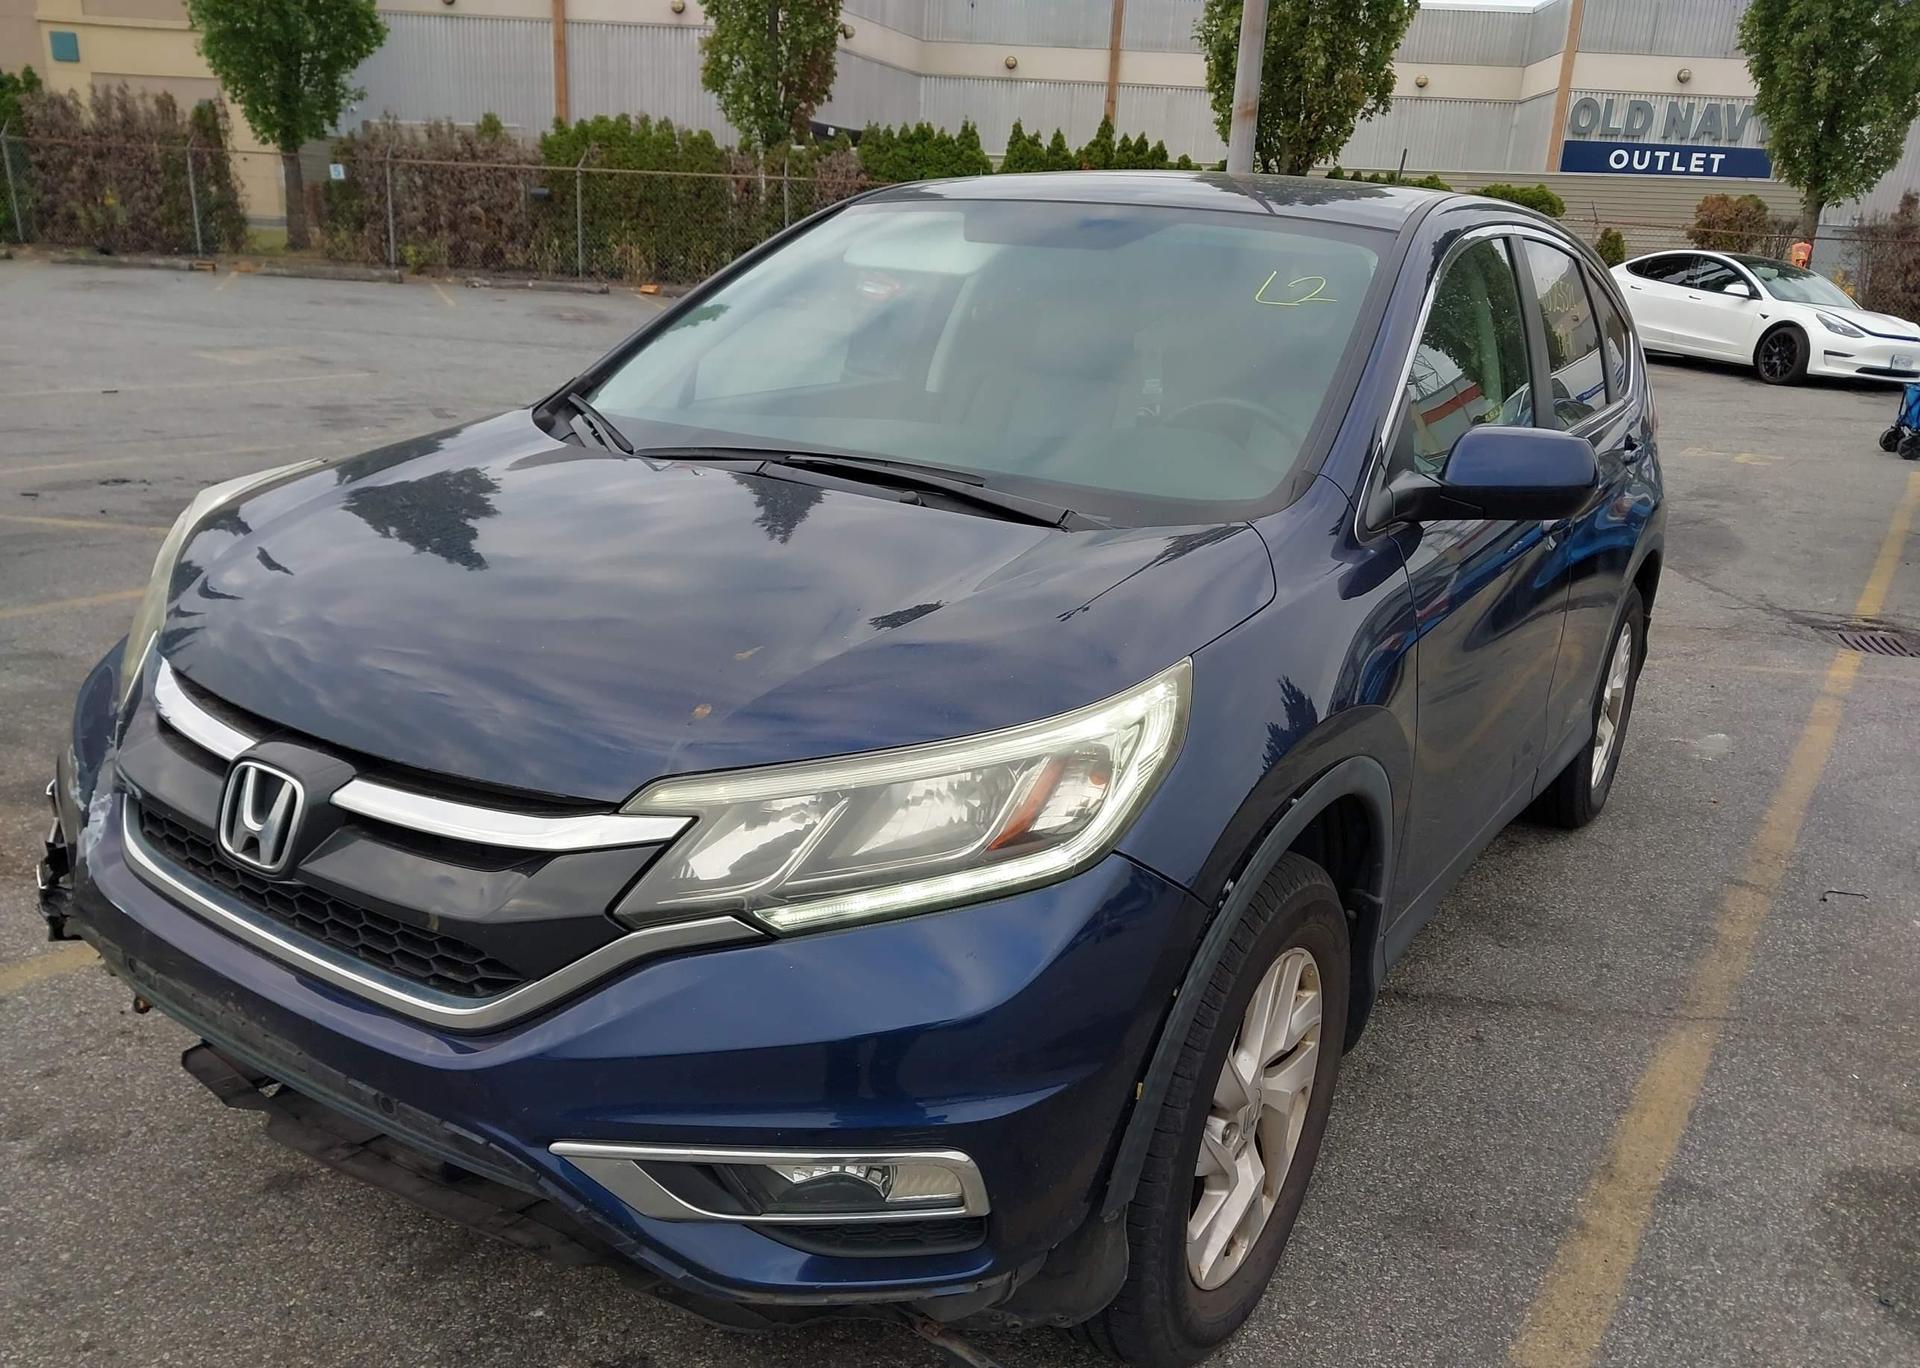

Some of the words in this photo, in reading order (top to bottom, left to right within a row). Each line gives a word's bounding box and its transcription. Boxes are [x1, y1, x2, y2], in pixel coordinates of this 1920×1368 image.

[1569, 96, 1654, 137] OLD
[1608, 149, 1726, 174] OUTLET
[1255, 270, 1337, 306] L2
